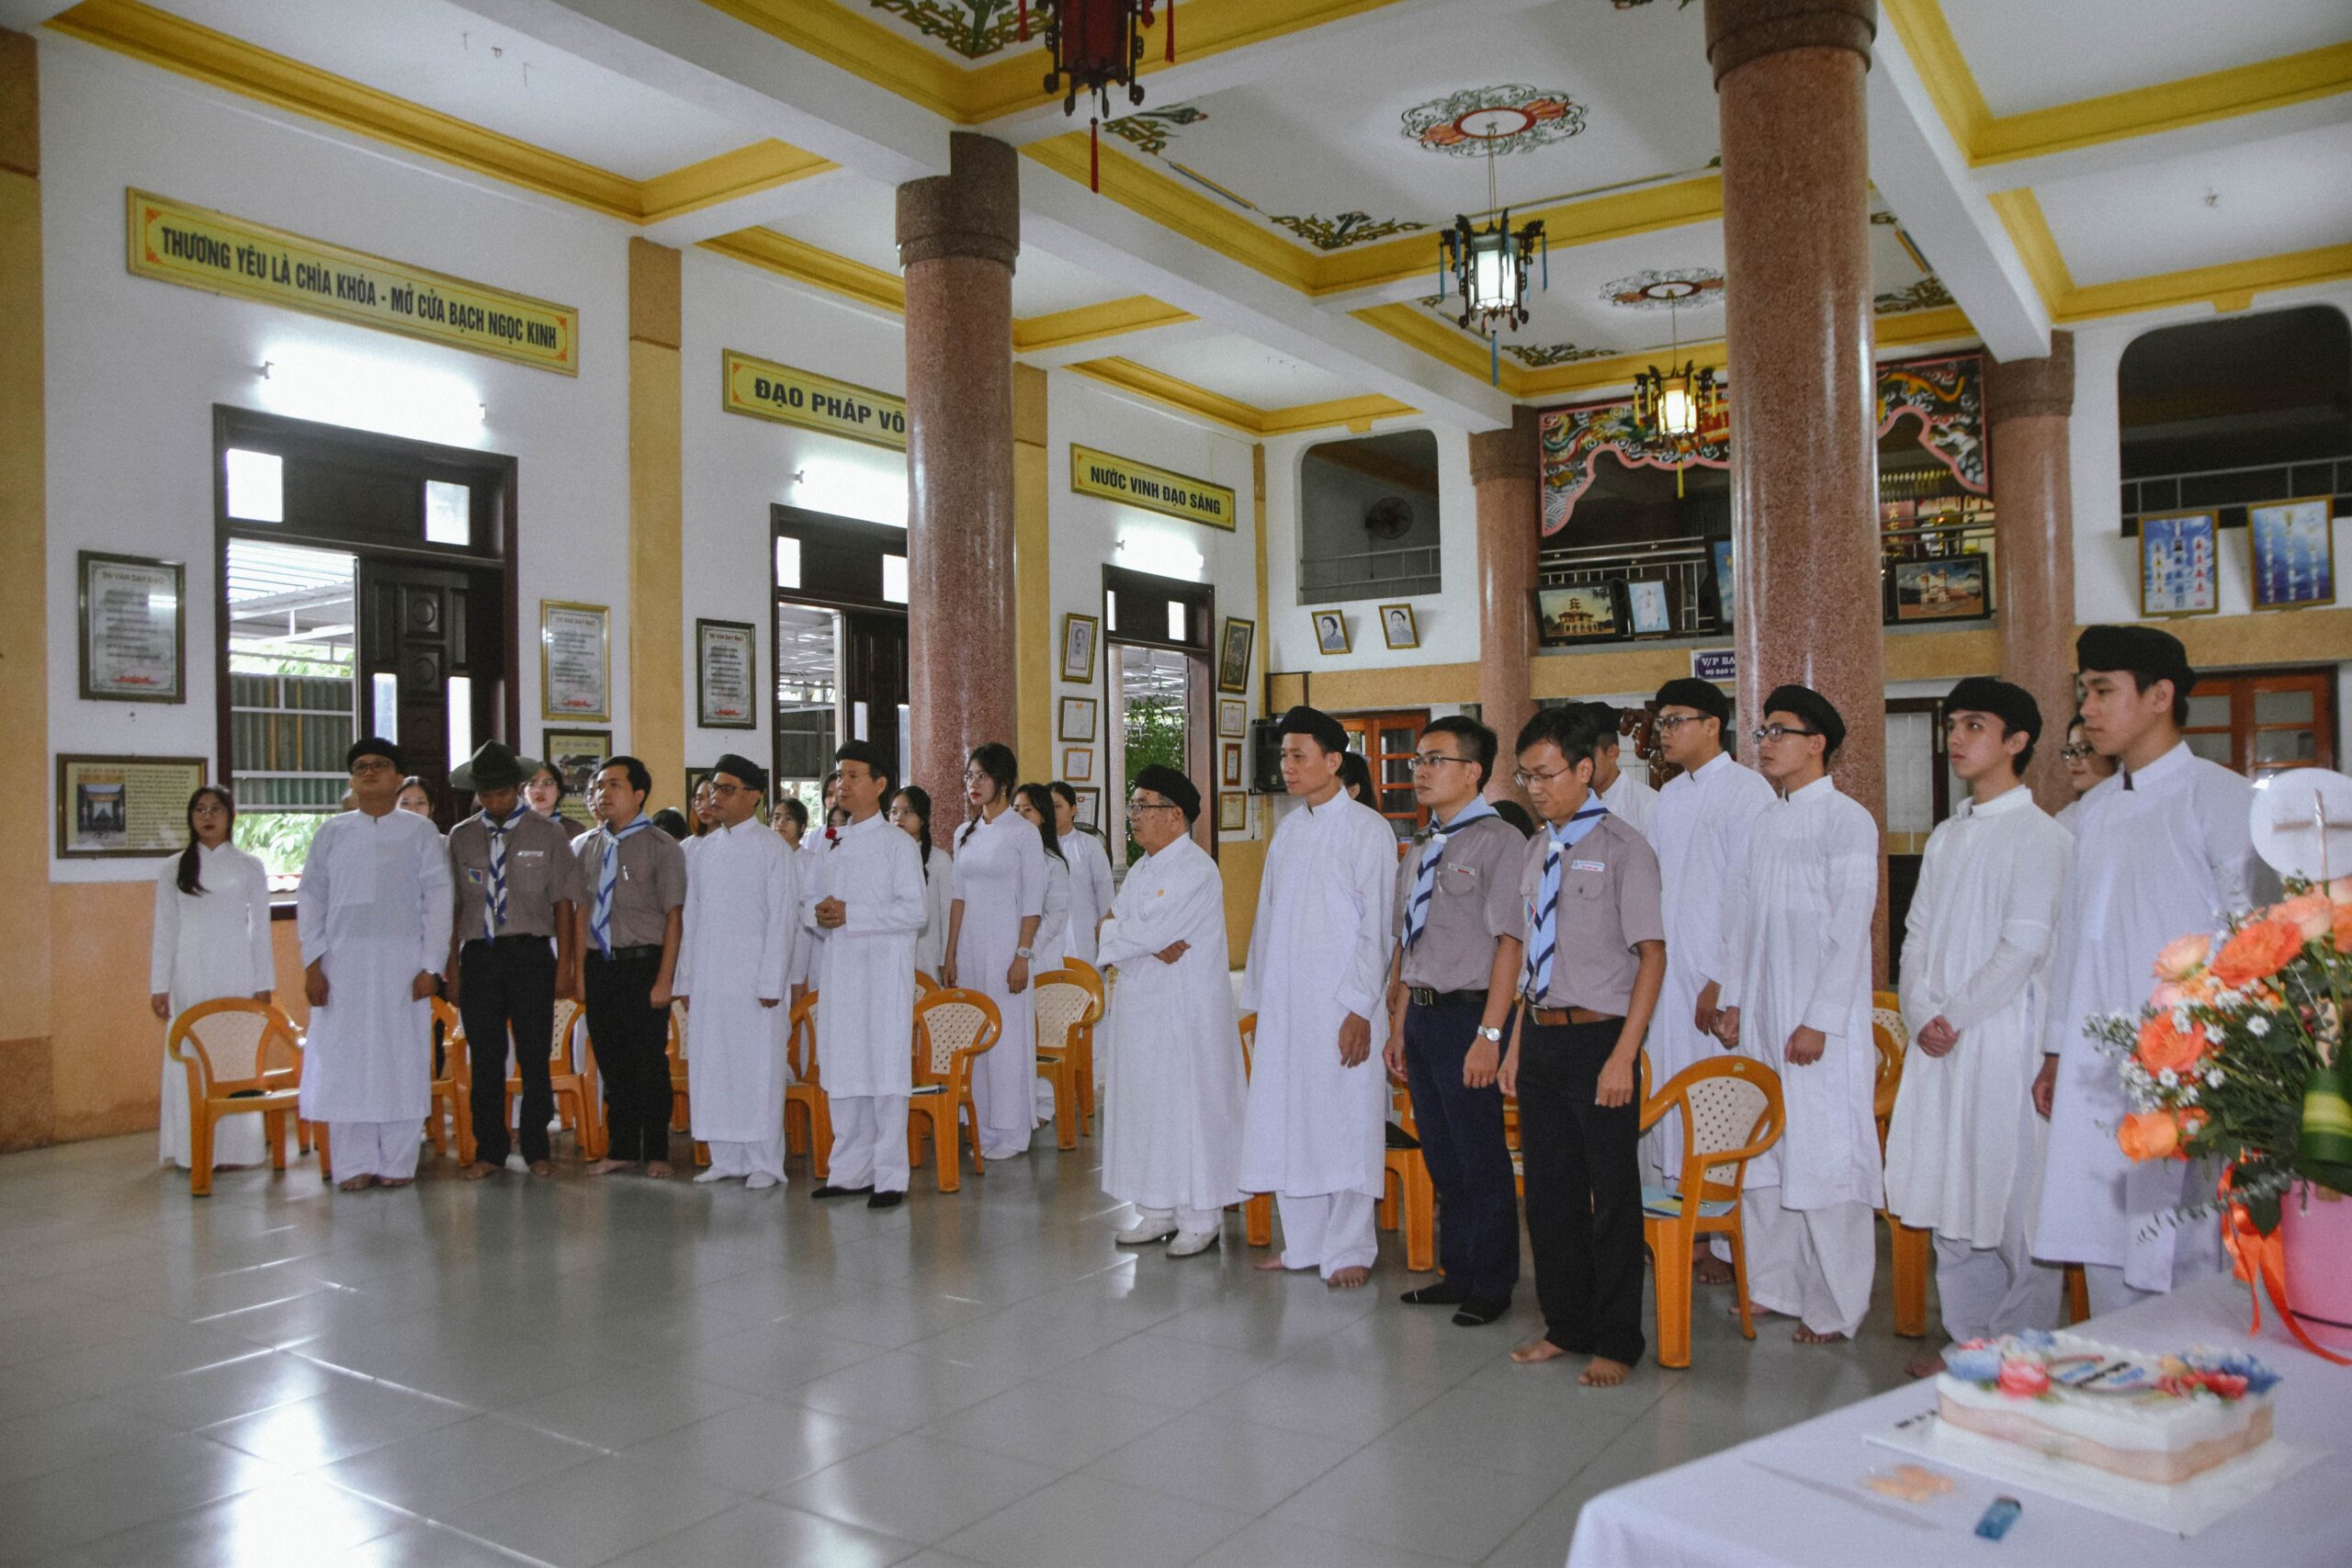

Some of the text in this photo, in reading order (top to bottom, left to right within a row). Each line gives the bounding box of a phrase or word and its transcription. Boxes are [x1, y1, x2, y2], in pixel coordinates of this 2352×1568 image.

[162, 226, 231, 269] THƯƠNG
[236, 244, 266, 278] YÊU
[272, 253, 291, 286] LÀ
[296, 262, 333, 296] CHÌA
[336, 273, 377, 307] KHÓA
[390, 282, 413, 315] MỞ
[418, 288, 446, 323] CỬA
[449, 301, 485, 333] BẠCH
[489, 310, 523, 344] NGỌC
[526, 321, 557, 349] KINH
[754, 378, 906, 434] ĐẠO PHÁP VÔ
[1091, 466, 1221, 515] NƯỚC VINH ĐẠO SÁNG
[1702, 657, 1719, 667] V/P
